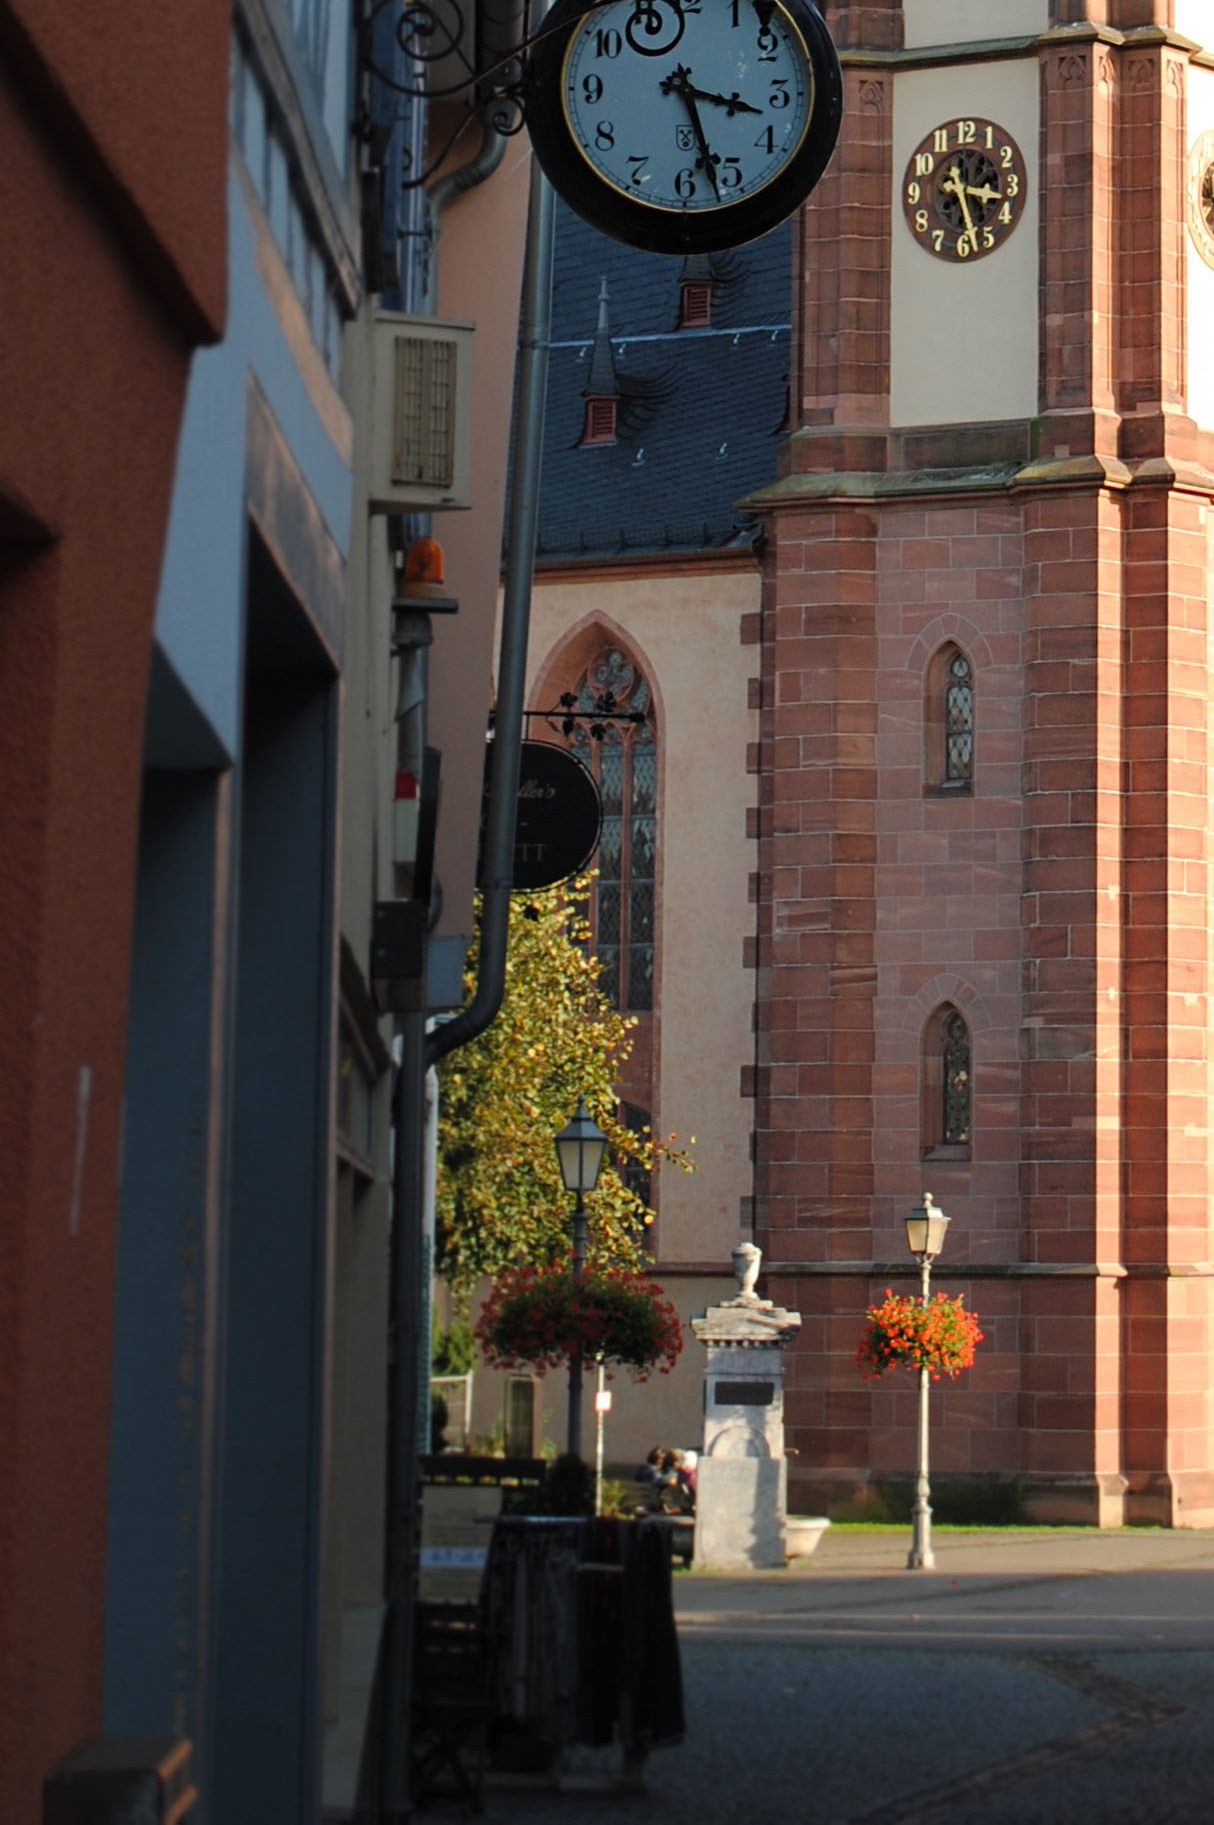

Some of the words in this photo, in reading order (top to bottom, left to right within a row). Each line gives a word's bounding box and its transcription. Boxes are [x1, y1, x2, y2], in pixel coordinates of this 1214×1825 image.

[595, 28, 623, 59] 10
[757, 31, 779, 62] 2
[582, 74, 603, 105] 9
[769, 79, 790, 109] 3
[594, 120, 616, 151] 8
[753, 124, 780, 154] 4
[933, 128, 948, 152] 11
[956, 120, 976, 144] 12
[985, 125, 994, 149] 1
[914, 152, 934, 176] 10
[1000, 145, 1013, 168] 2
[626, 155, 650, 186] 7
[721, 157, 743, 187] 5
[674, 168, 696, 199] 6
[907, 182, 920, 204] 9
[1006, 174, 1019, 196] 3
[915, 209, 928, 232] 8
[998, 201, 1013, 224] 4
[932, 229, 945, 252] 7
[956, 235, 970, 258] 6
[983, 226, 995, 248] 5
